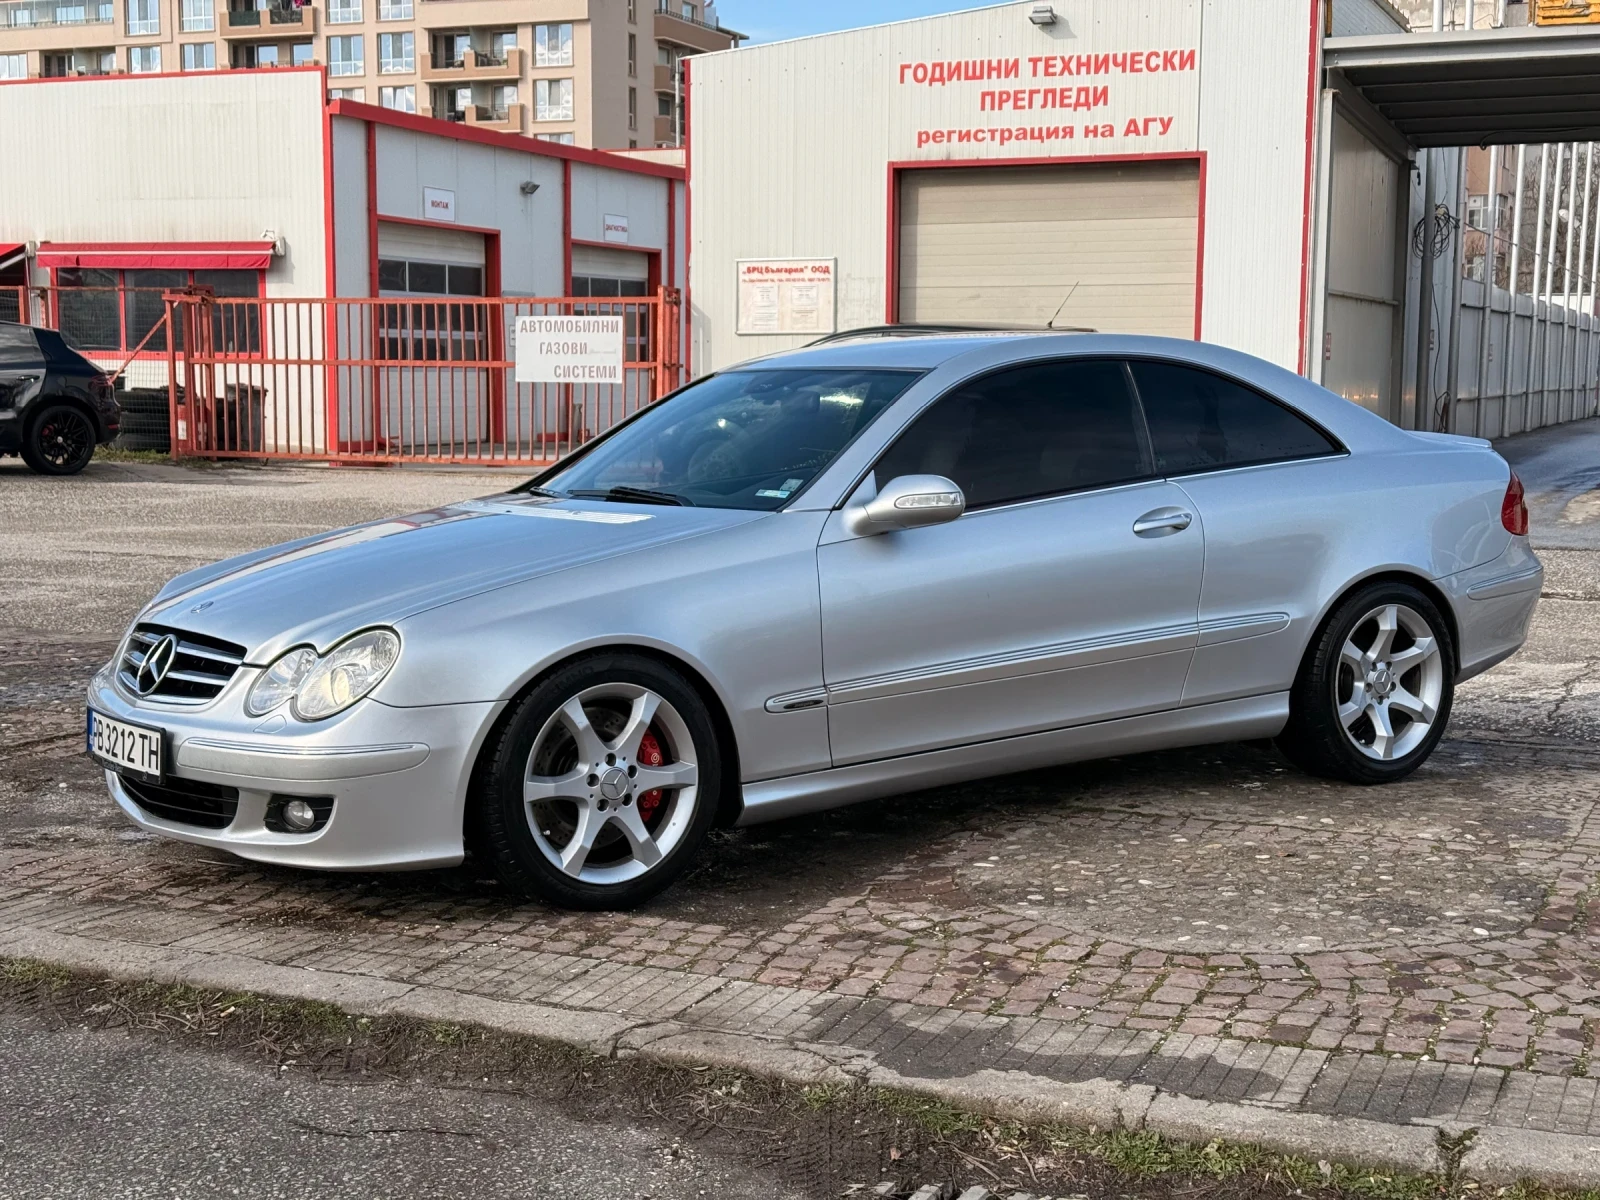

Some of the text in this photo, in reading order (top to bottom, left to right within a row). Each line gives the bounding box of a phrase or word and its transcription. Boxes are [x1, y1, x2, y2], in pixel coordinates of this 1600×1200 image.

[899, 49, 1196, 86] ГОДИШНИ ТЕХНИЧЕСКИ
[980, 85, 1109, 111] ПРЕГЛЕДИ
[917, 116, 1174, 148] регистрация на АГУ
[431, 199, 449, 209] МОНТАЖ
[811, 266, 830, 275] ООД
[520, 320, 619, 333] АВТОМОБИЛНИ
[539, 342, 588, 355] ГАЗОВИ
[554, 365, 617, 379] СИСТЕМИ
